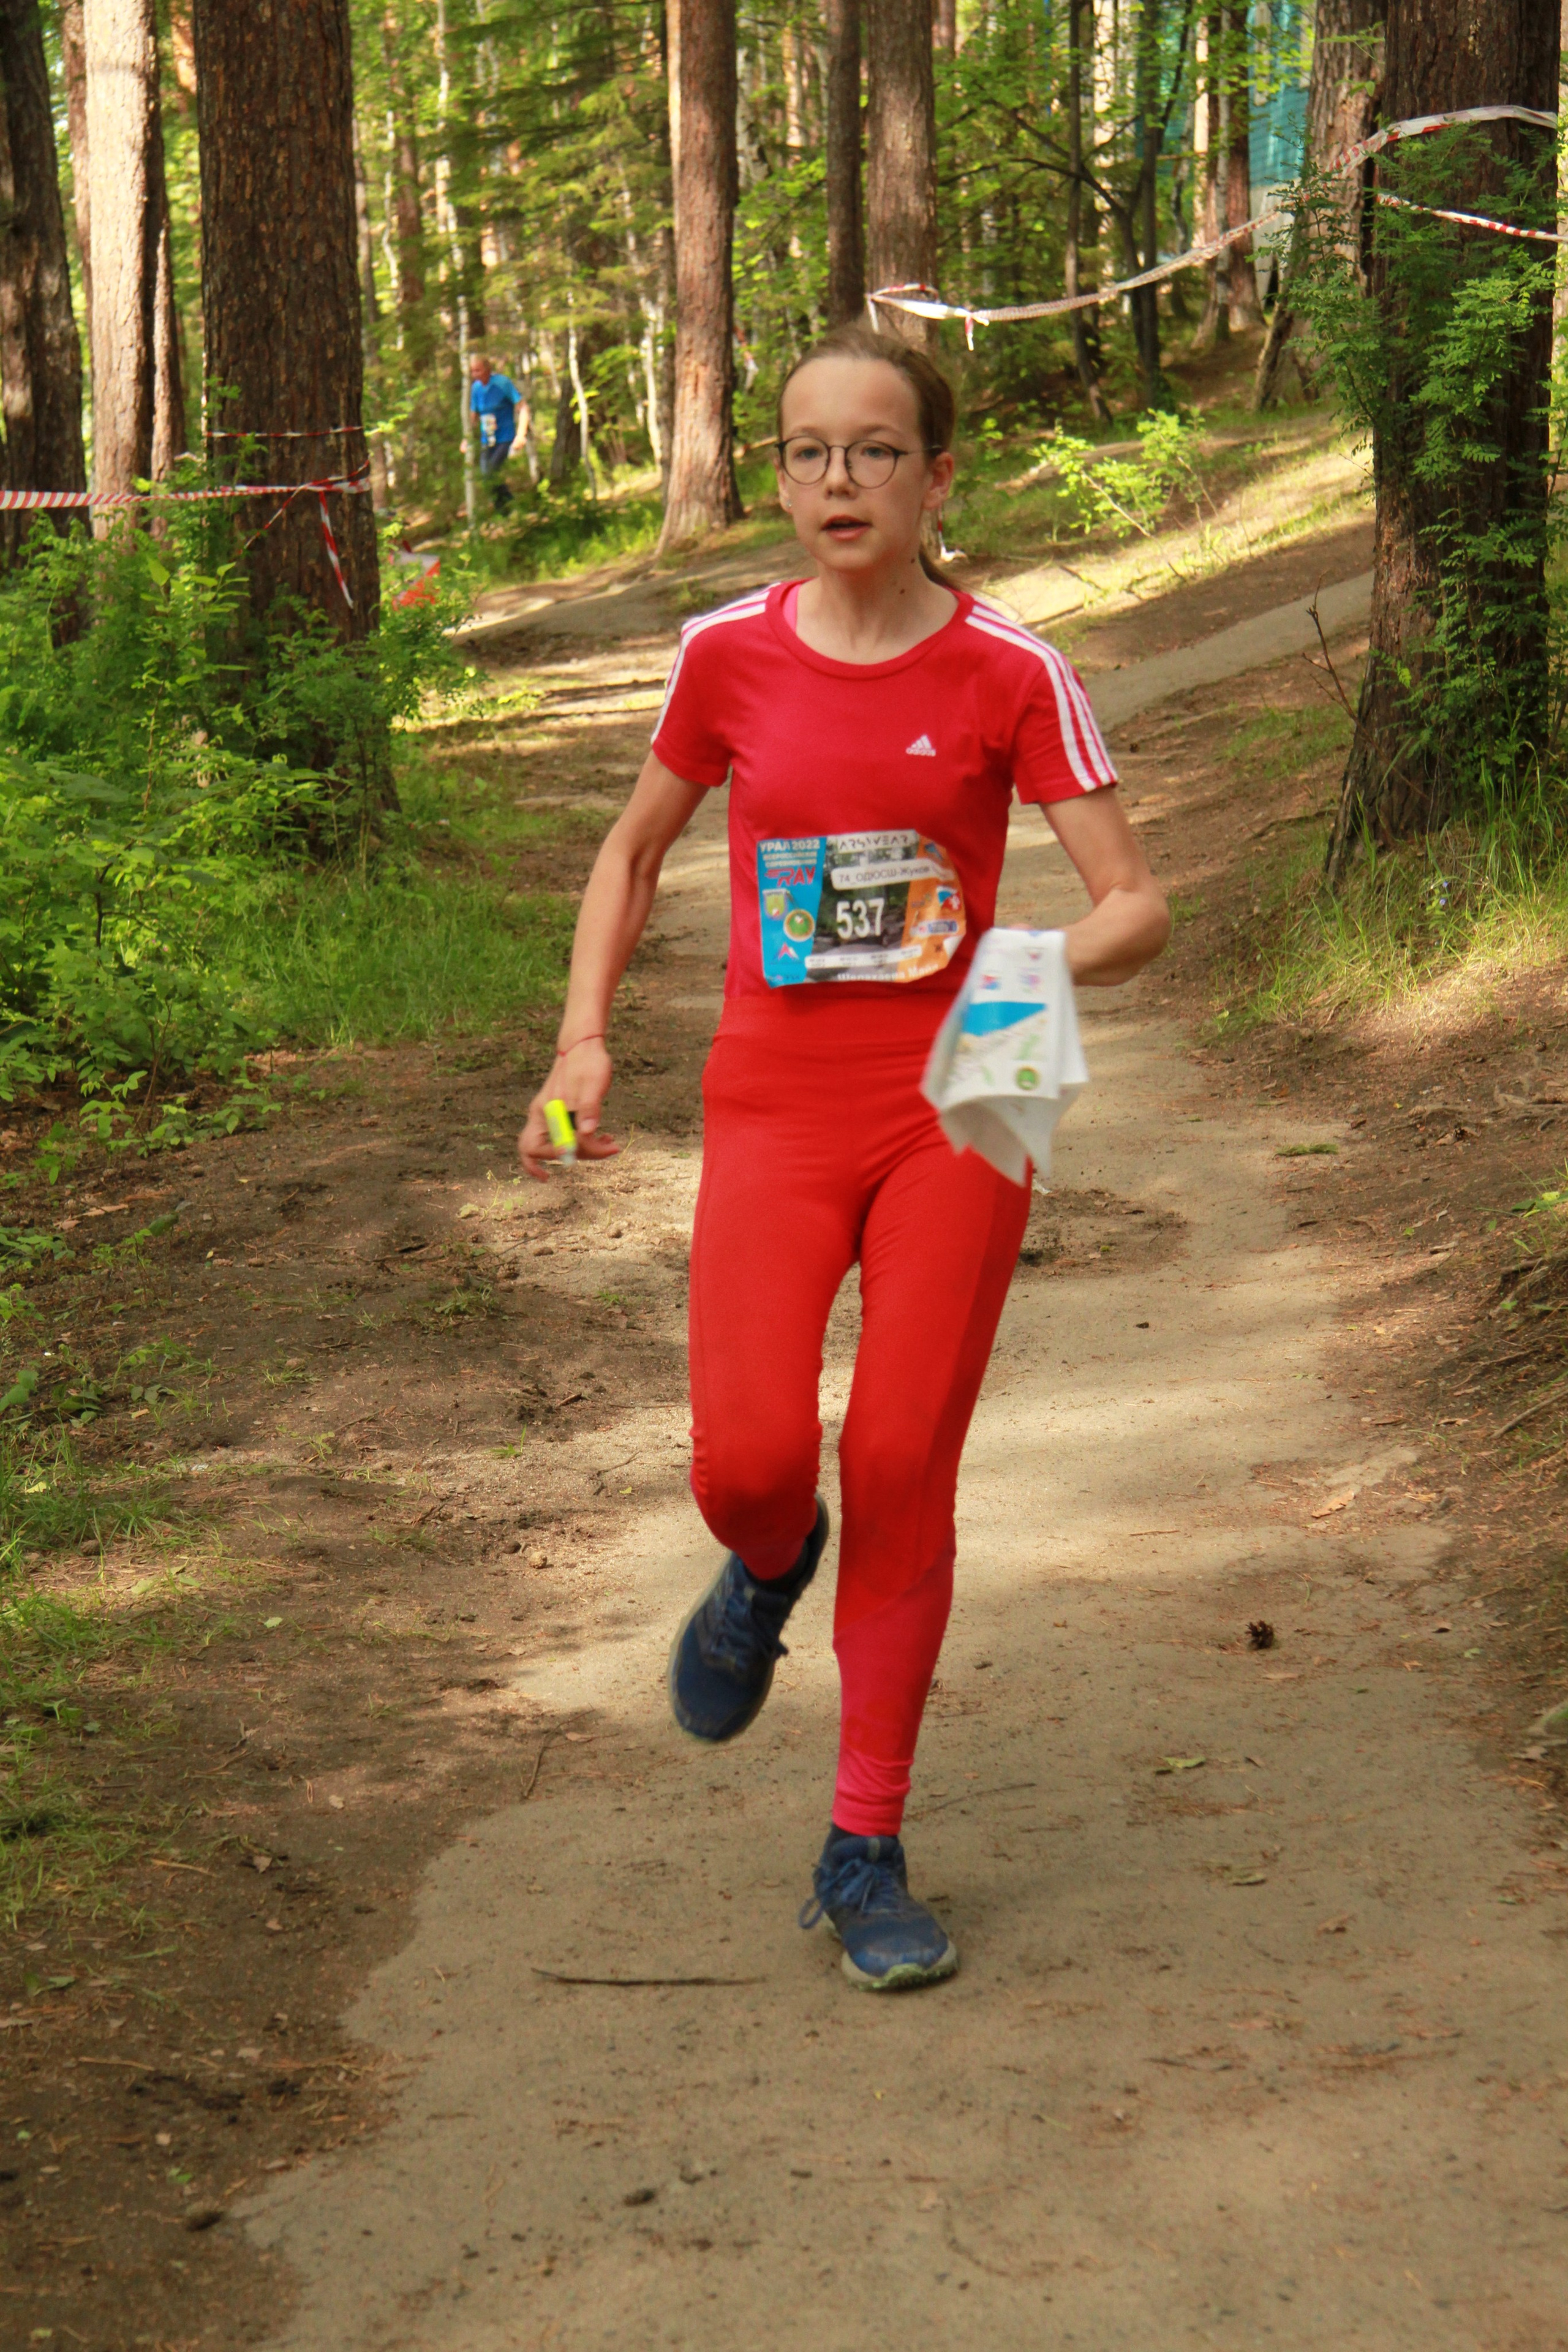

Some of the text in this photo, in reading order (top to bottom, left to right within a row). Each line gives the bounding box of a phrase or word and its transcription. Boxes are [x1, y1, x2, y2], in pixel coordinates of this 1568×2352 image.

[760, 839, 820, 853] УРАЛ 2022
[835, 897, 884, 938] 537
